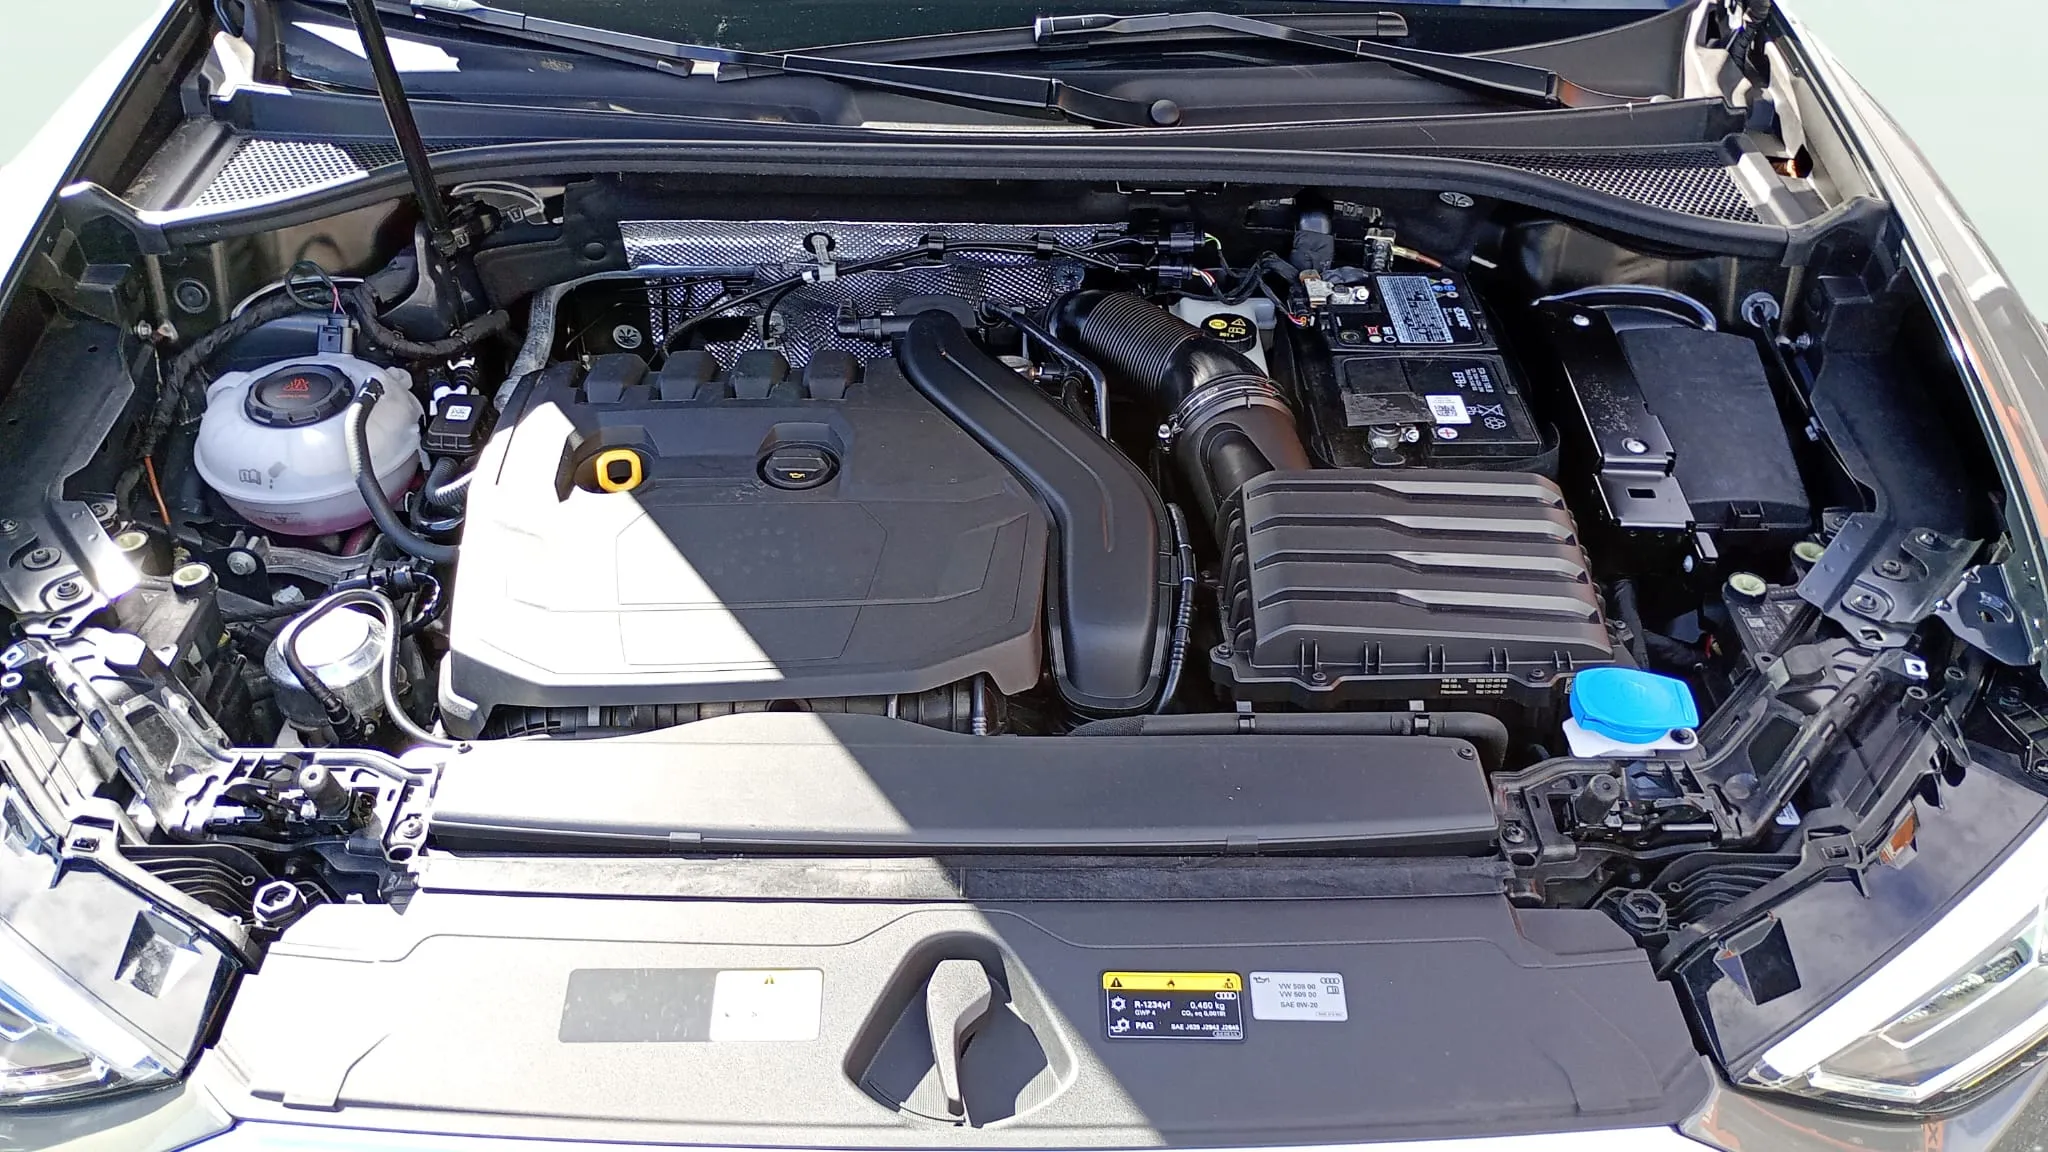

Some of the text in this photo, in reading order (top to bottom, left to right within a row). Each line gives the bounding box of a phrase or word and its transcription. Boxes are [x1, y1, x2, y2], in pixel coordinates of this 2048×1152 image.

[1134, 1000, 1171, 1010] R-1234yf
[1214, 1001, 1225, 1011] kg
[1135, 1021, 1154, 1030] PAG
